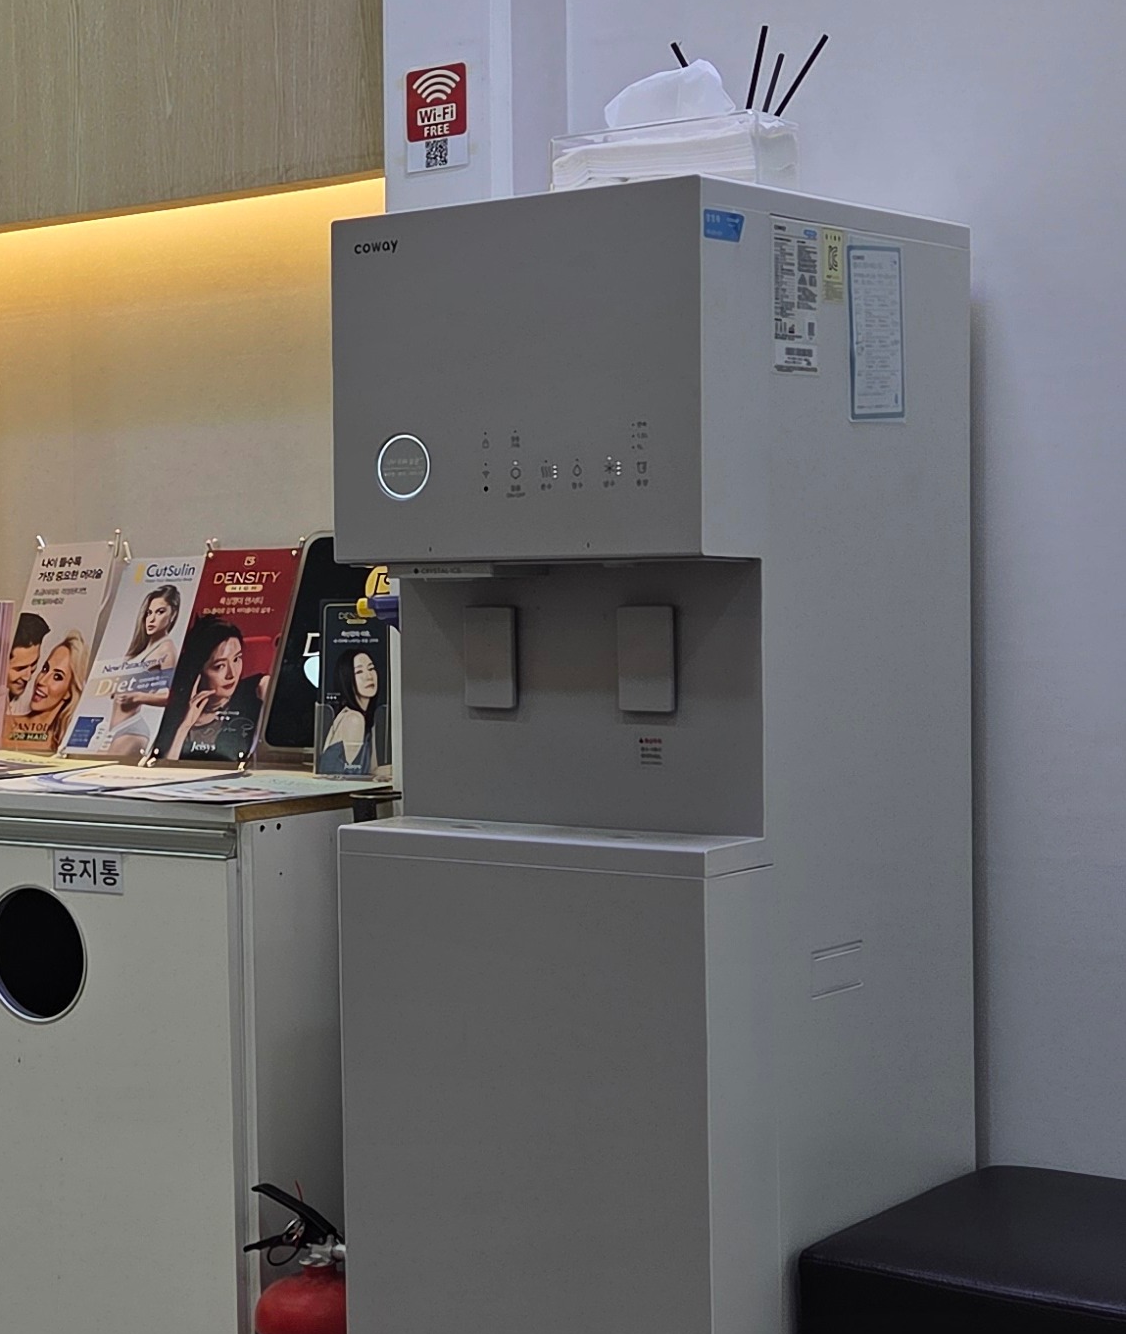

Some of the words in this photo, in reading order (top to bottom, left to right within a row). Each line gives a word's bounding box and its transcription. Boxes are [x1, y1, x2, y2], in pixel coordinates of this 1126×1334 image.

[419, 105, 454, 124] Wi-Fi
[424, 123, 450, 138] FREE
[354, 238, 398, 255] coway
[146, 563, 196, 578] CutSulin
[213, 571, 282, 585] DENSITY
[95, 677, 136, 696] Diet
[27, 733, 48, 741] HAIR
[58, 856, 120, 886] 휴지통
